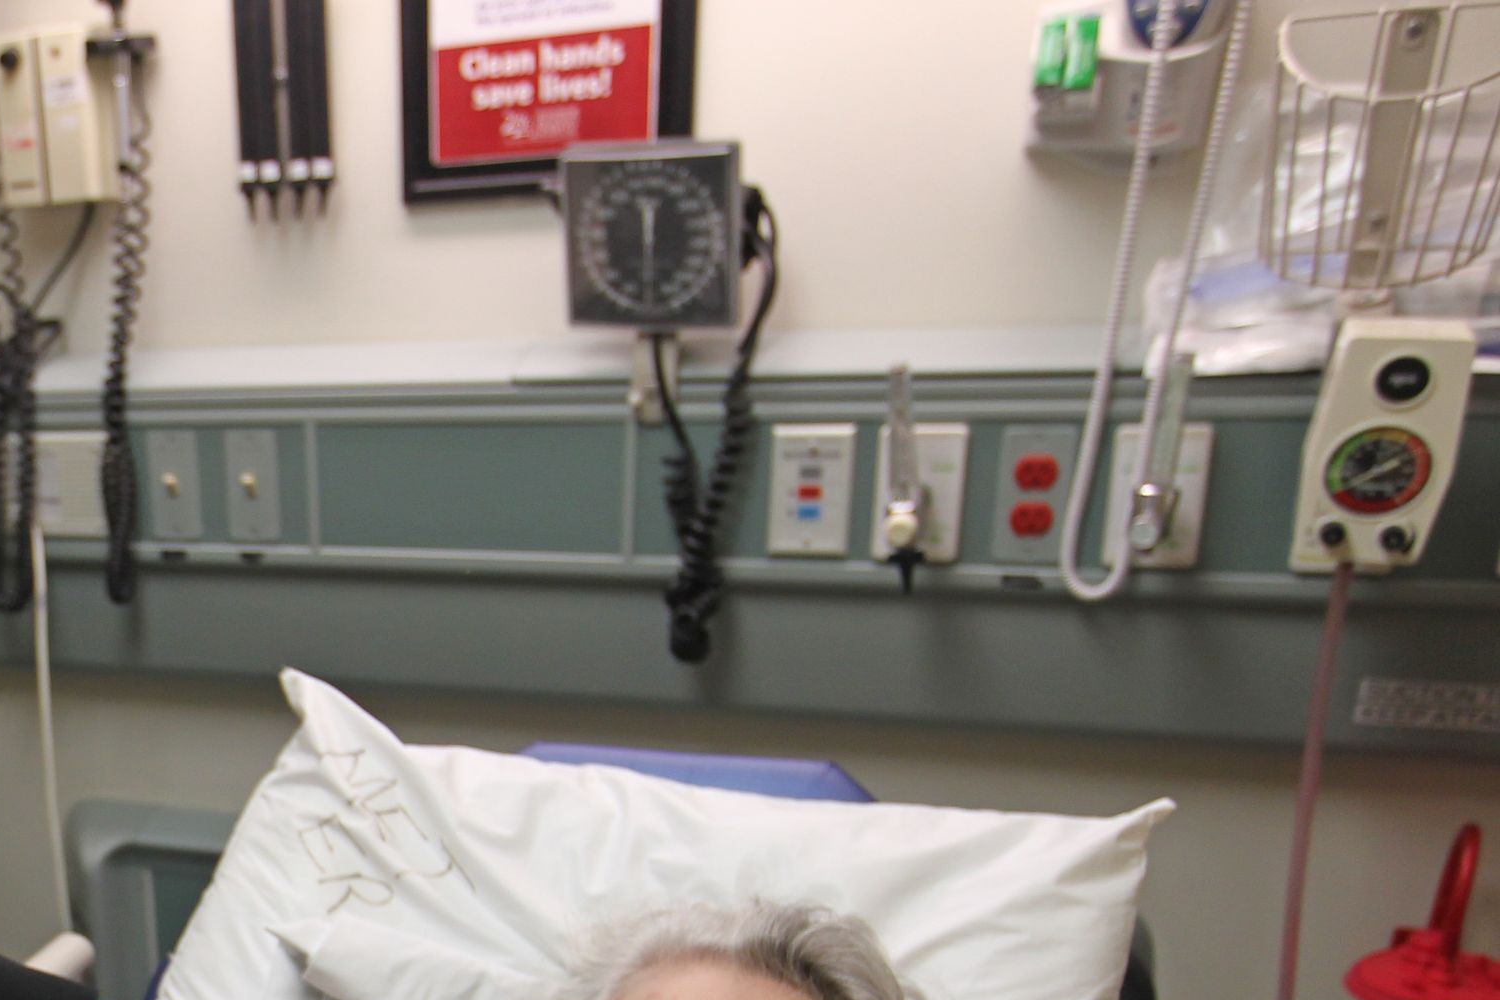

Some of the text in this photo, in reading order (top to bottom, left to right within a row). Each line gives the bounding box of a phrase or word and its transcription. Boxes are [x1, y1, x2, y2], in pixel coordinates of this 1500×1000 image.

[458, 33, 626, 82] Clean hands
[471, 66, 614, 111] save lives!
